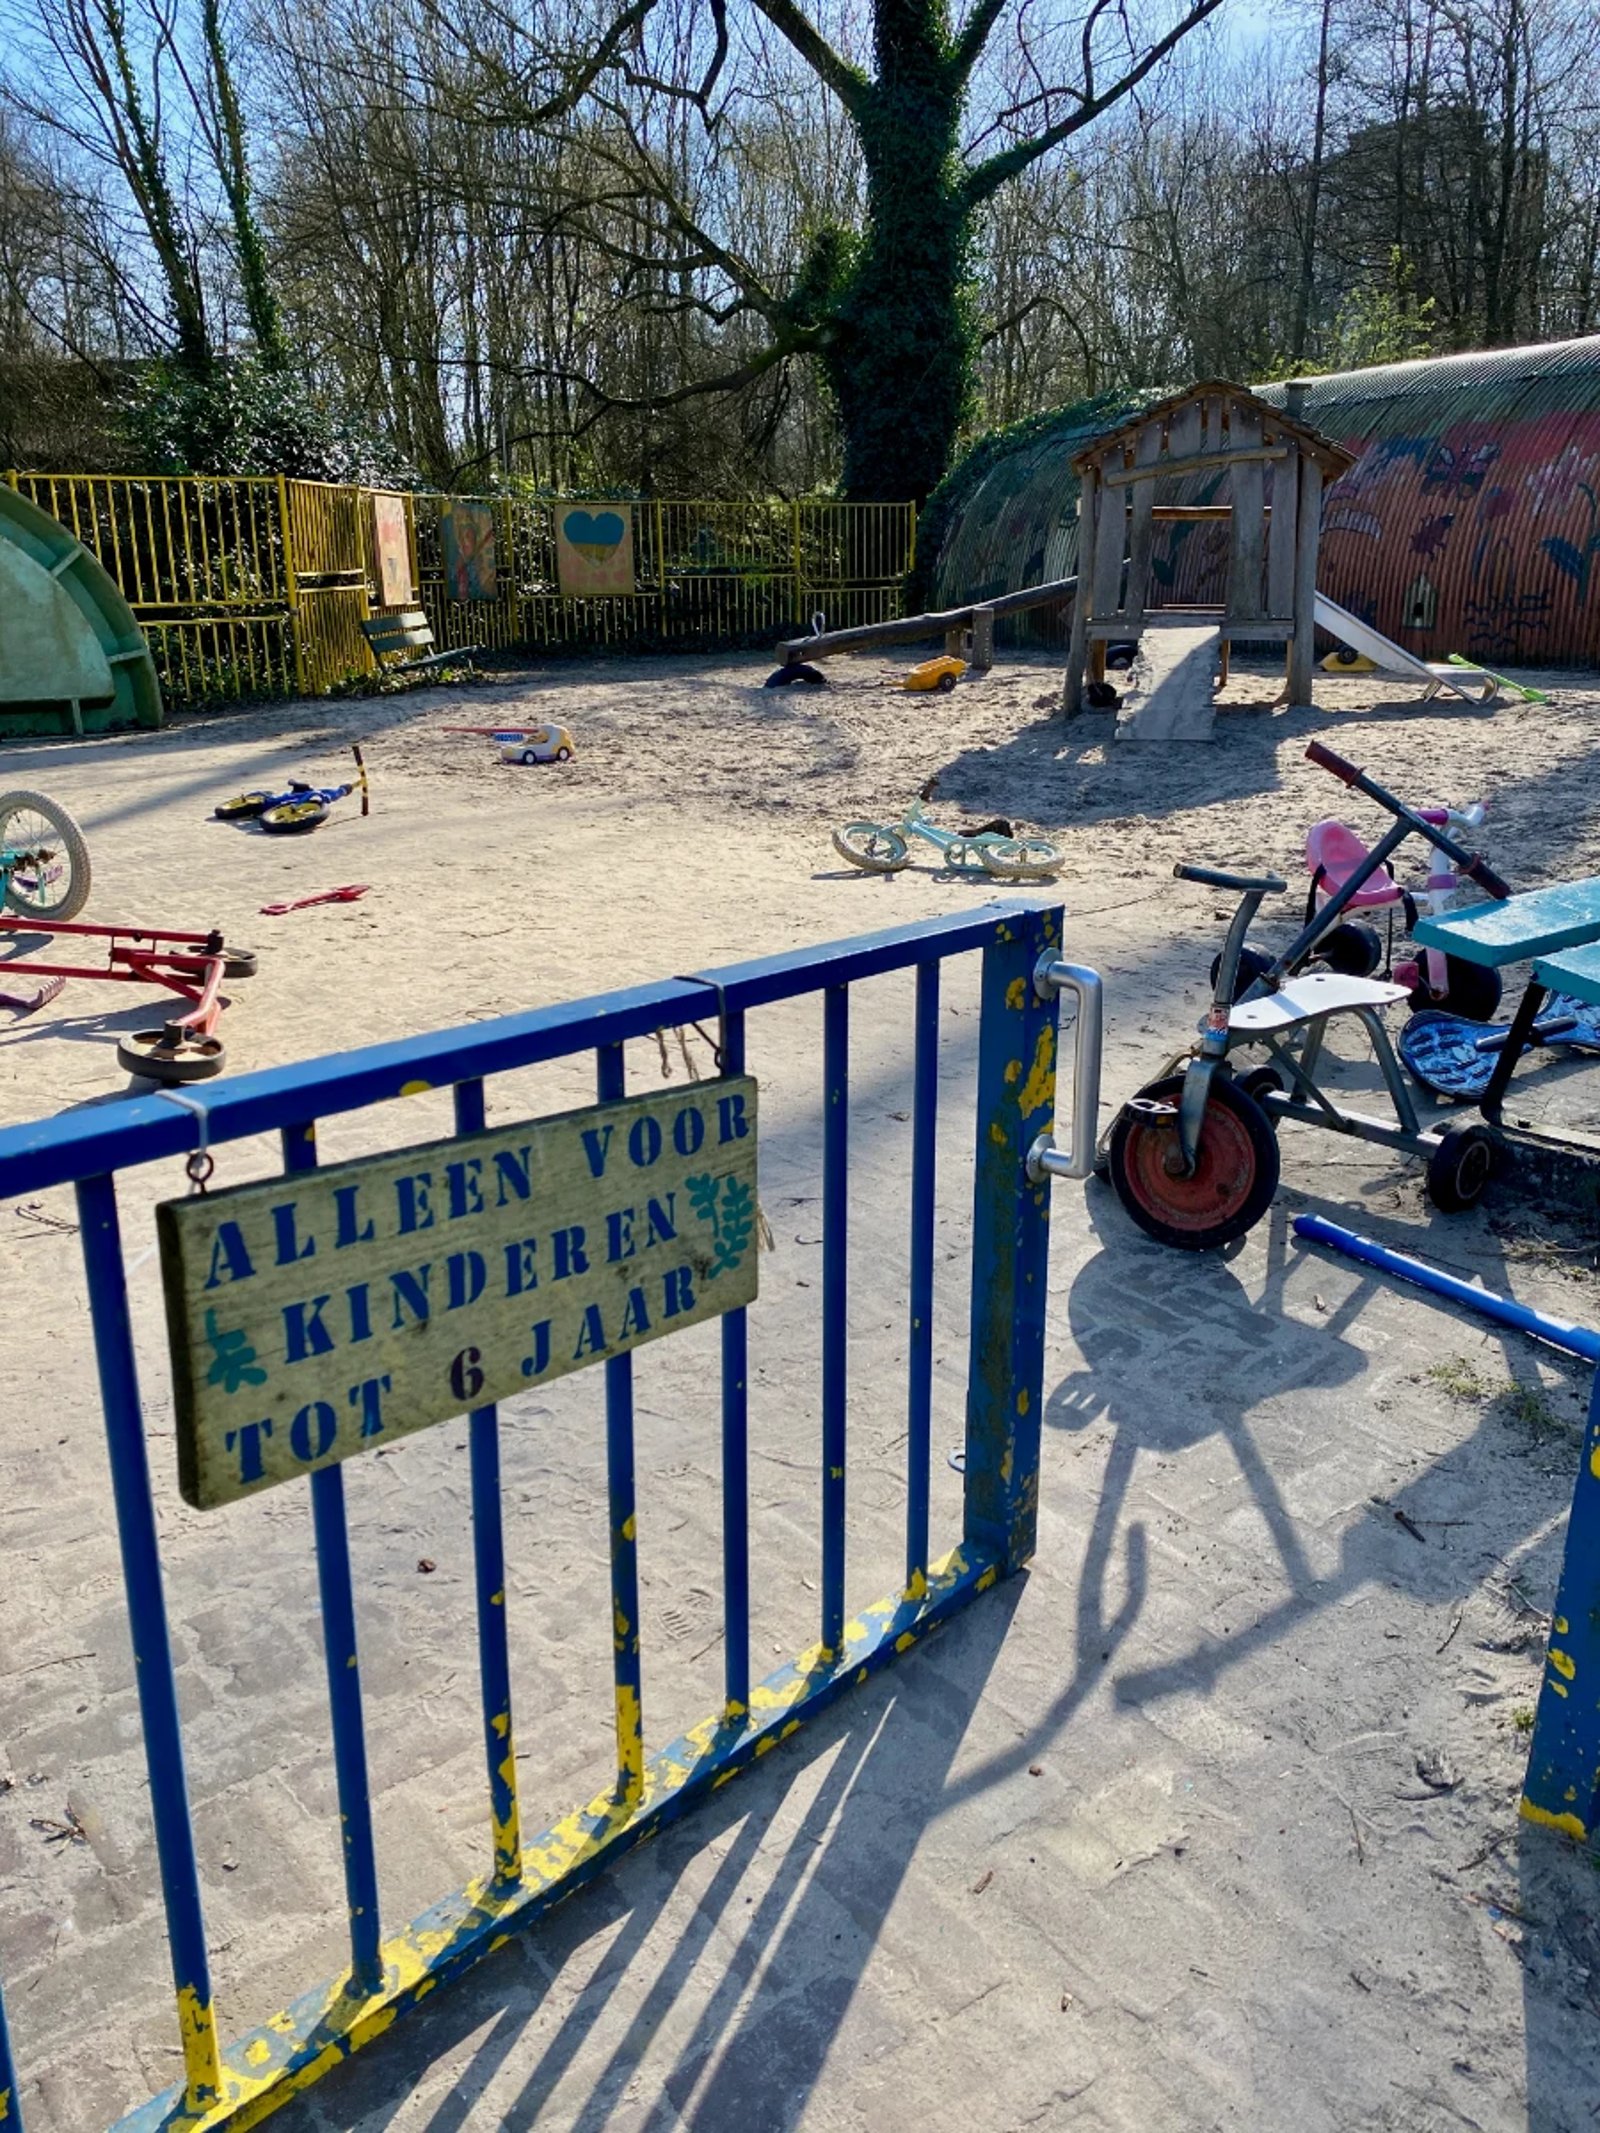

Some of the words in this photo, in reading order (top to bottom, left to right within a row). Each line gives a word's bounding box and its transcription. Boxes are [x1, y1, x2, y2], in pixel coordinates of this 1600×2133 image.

[204, 1146, 533, 1290] ALLEEN
[581, 1094, 751, 1178] VOOR
[281, 1192, 679, 1364] KINDEREN
[225, 1374, 393, 1485] TOT
[449, 1346, 486, 1401] 6
[521, 1265, 697, 1377] JAAR
